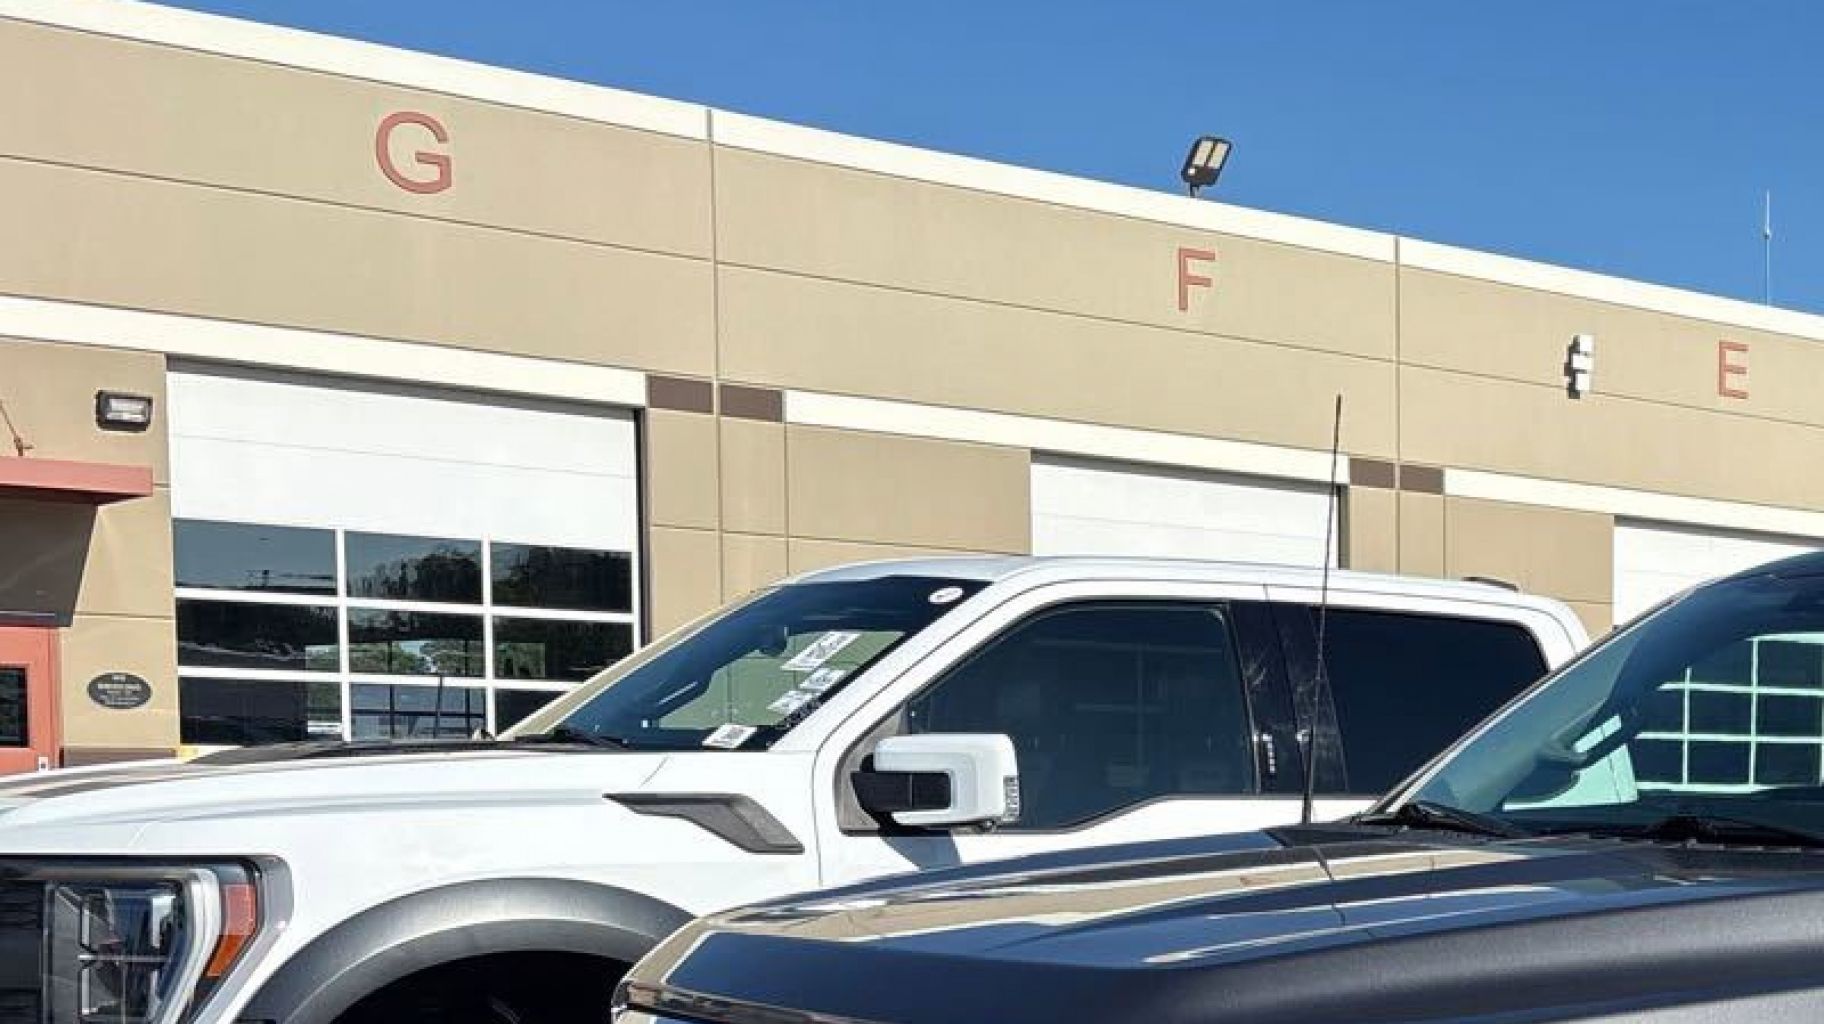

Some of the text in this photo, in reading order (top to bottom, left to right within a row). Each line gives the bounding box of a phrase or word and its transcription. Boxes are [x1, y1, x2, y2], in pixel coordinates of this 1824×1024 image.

[375, 111, 452, 194] G
[1178, 248, 1216, 312] F
[1718, 340, 1749, 400] E
